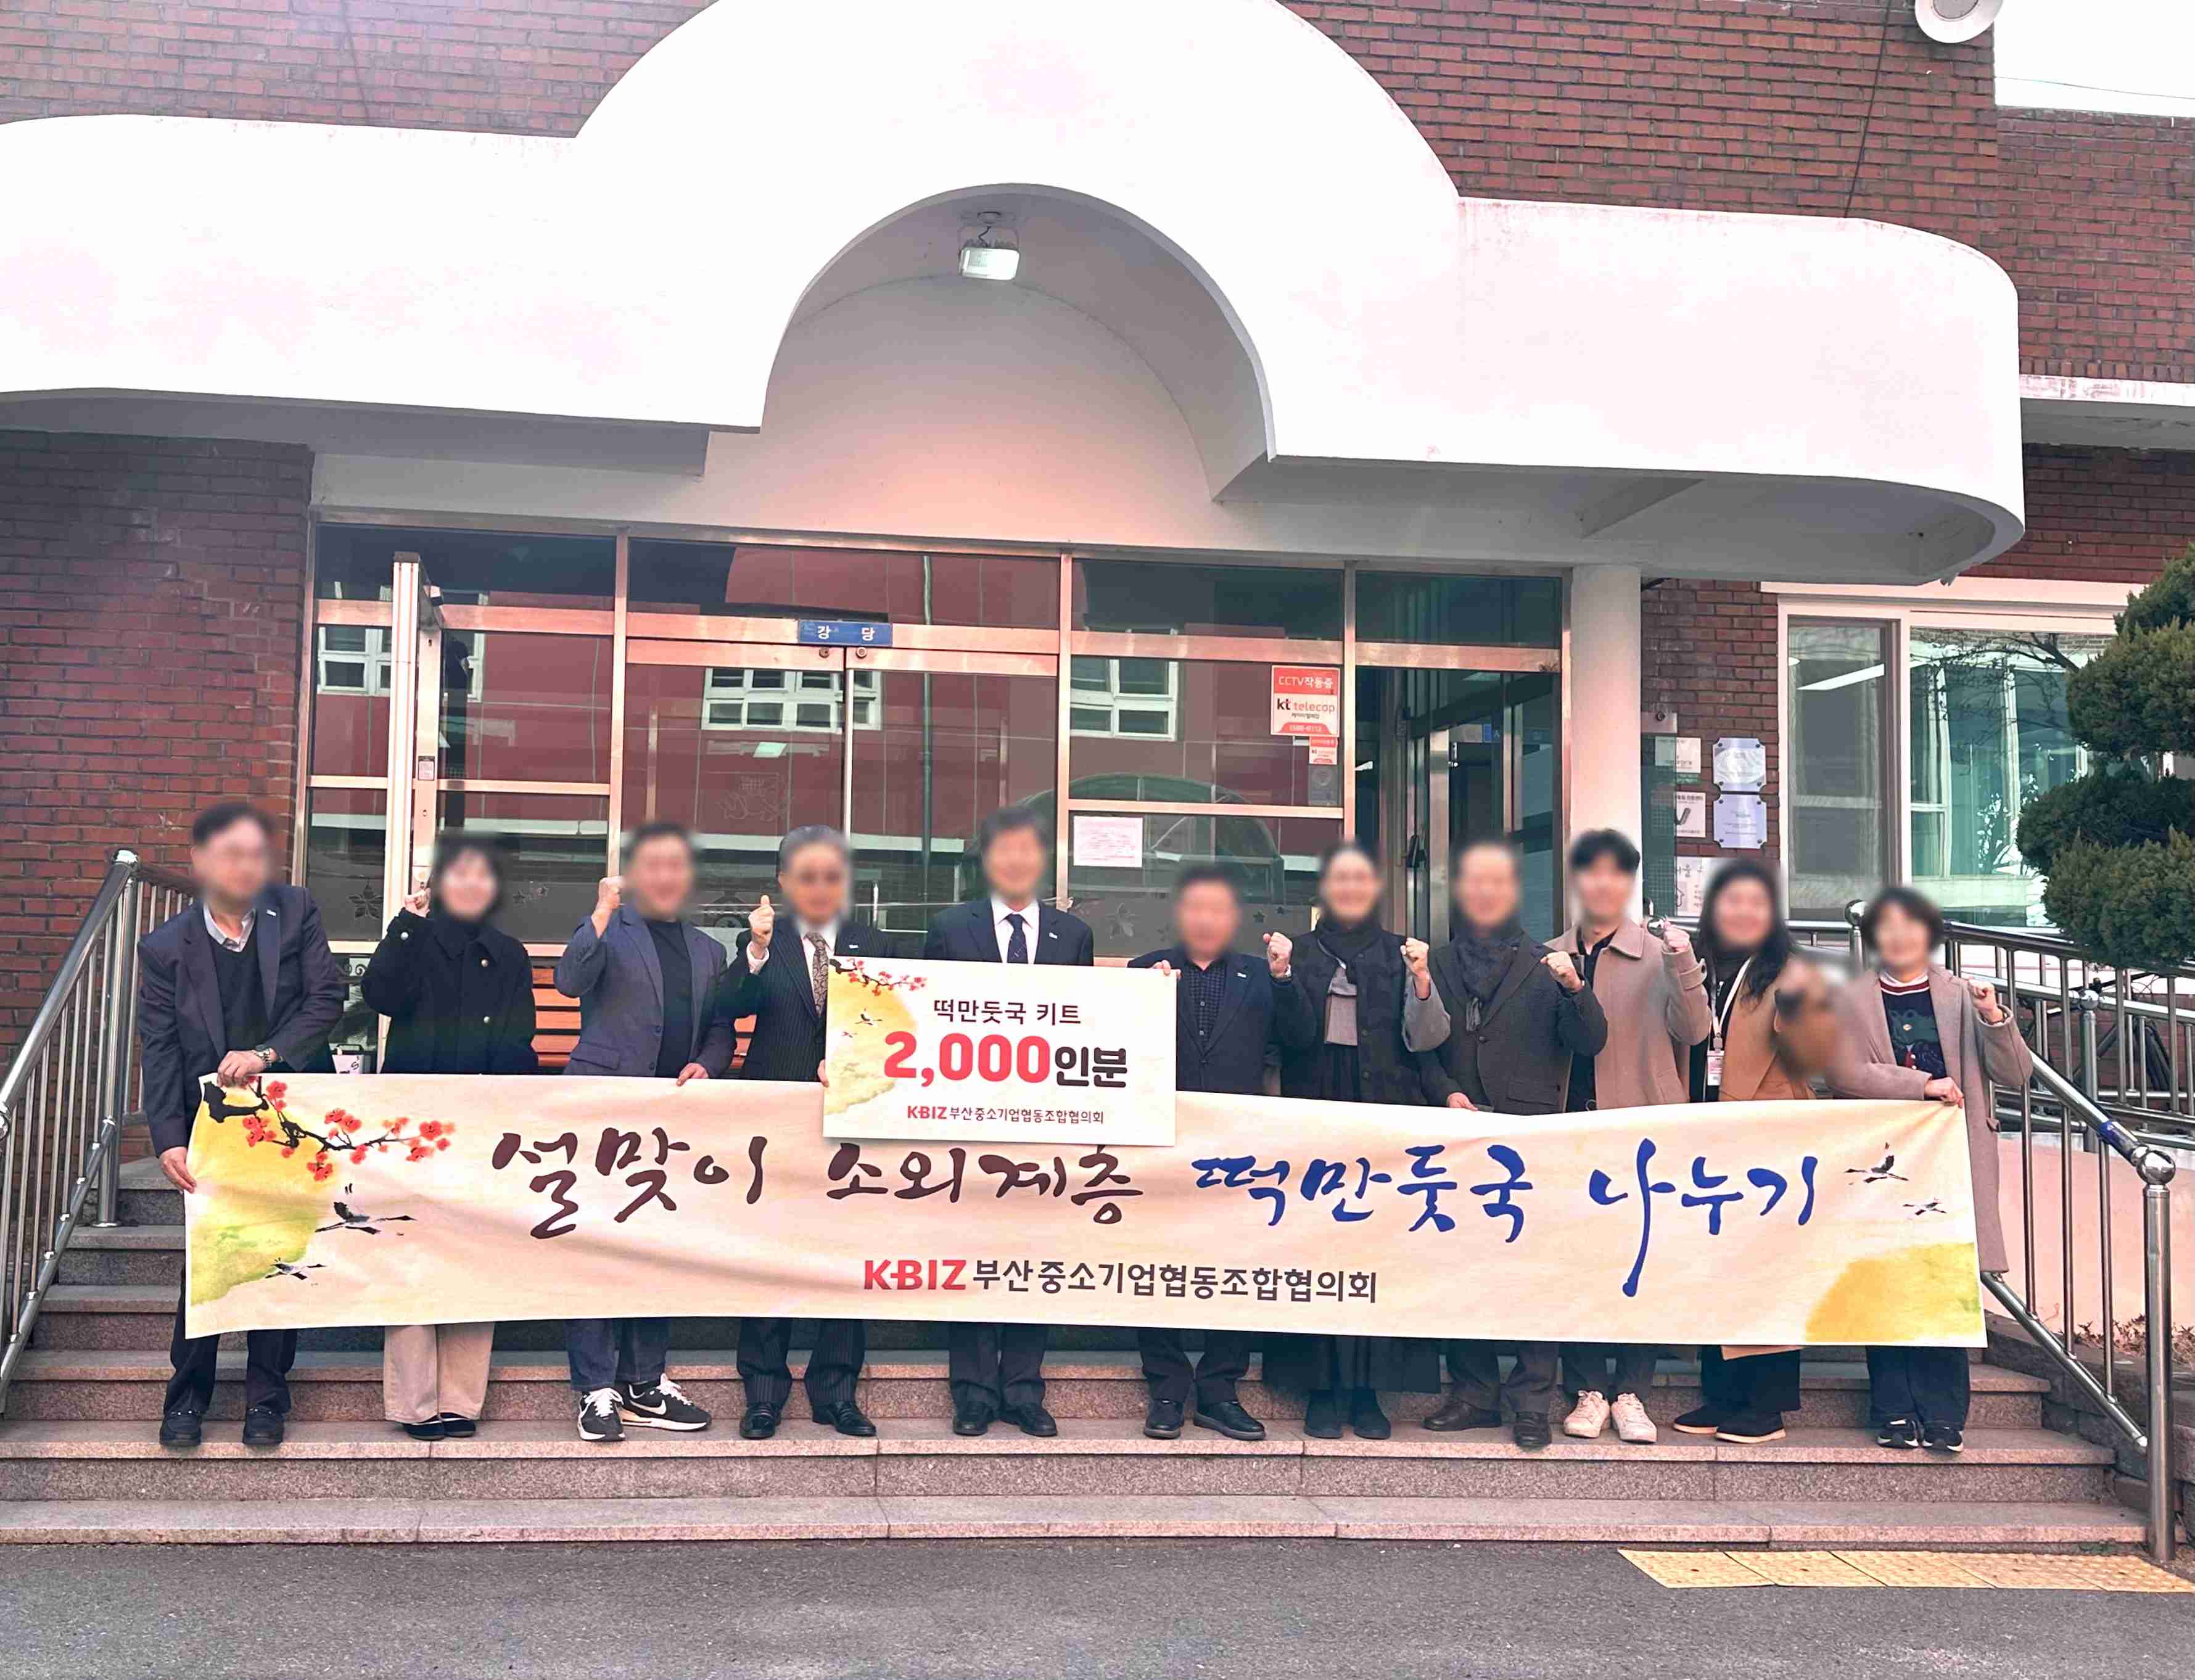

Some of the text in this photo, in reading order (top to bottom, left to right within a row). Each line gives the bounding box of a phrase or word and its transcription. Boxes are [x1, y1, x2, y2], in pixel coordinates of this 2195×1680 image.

[1277, 698, 1335, 714] kt telecop
[934, 999, 1081, 1026] 떡만둣국 키트
[884, 1031, 1128, 1089] 2,000인분
[907, 1105, 947, 1119] KBIZ
[492, 1127, 1818, 1298] 설맞이 소외계층 떡만둣국 나누기
[863, 1259, 1377, 1304] KBIZ 부산중소기업협동조합협의회
